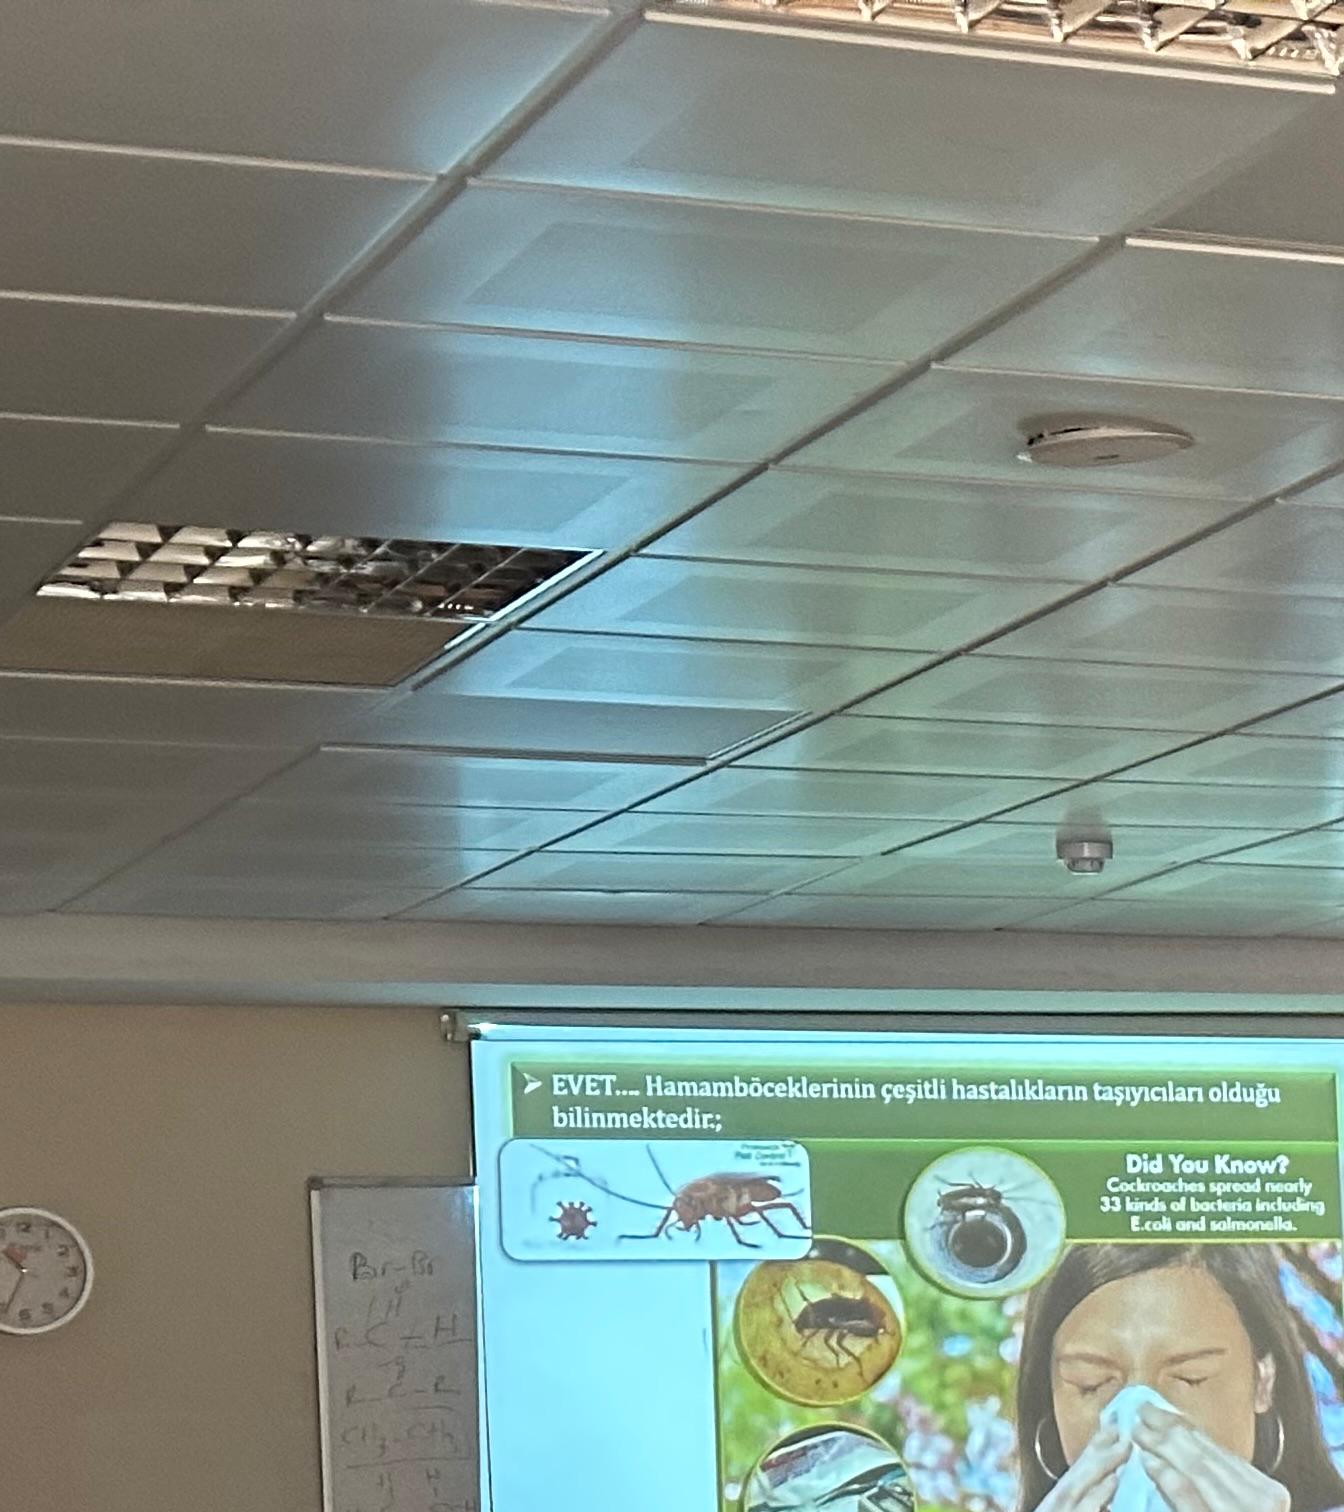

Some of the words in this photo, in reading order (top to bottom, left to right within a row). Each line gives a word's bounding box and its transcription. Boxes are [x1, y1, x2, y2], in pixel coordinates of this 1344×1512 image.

[646, 1075, 876, 1099] Hamamböceklerinin
[881, 1078, 946, 1105] çeşitli
[952, 1078, 1088, 1101] hastalıkların
[1093, 1081, 1204, 1107] taşıyıcıları
[1208, 1081, 1281, 1107] olduğu
[1126, 1154, 1163, 1174] Did
[1169, 1154, 1209, 1174] You
[1214, 1154, 1290, 1174] Know?
[1106, 1177, 1206, 1193] Cockroaches
[1209, 1177, 1261, 1196] spread
[1265, 1177, 1312, 1196] nearly
[1100, 1197, 1121, 1213] 33
[1125, 1197, 1166, 1213] kinds
[1170, 1197, 1187, 1213] of
[1190, 1197, 1253, 1213] bacteria
[1256, 1197, 1326, 1216] including
[1130, 1215, 1171, 1232] E.coli
[1175, 1215, 1205, 1232] and
[1209, 1216, 1298, 1232] salmonella.
